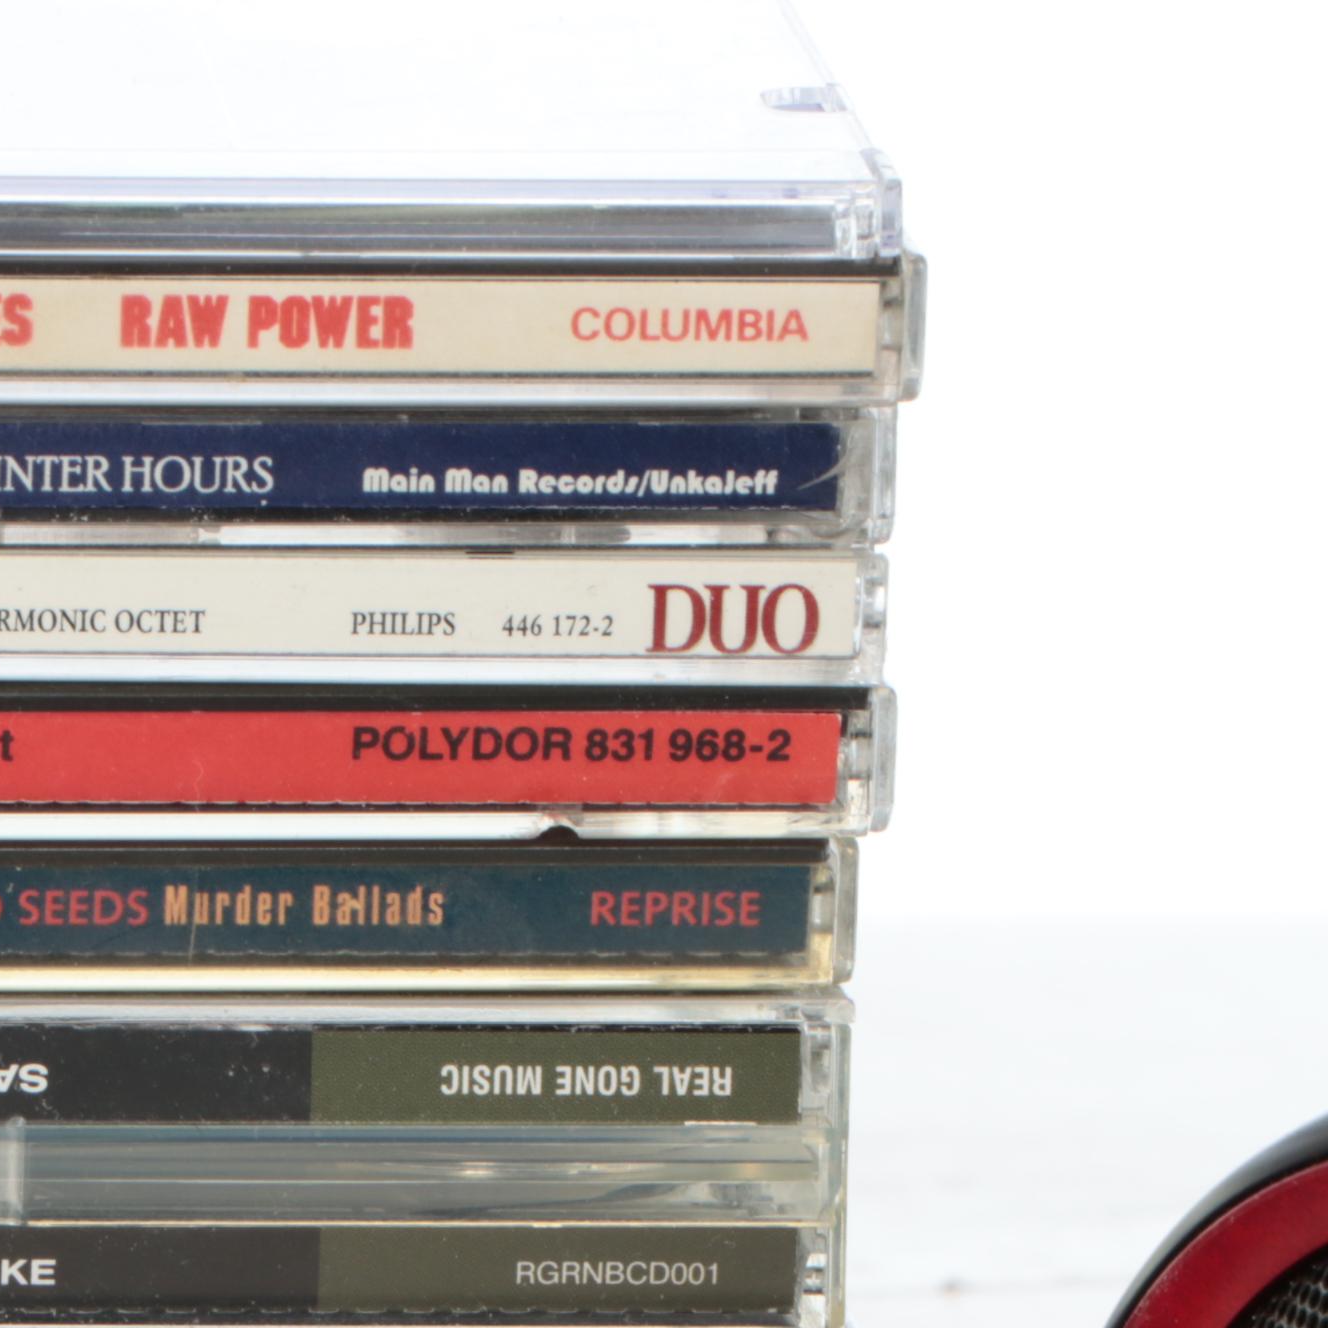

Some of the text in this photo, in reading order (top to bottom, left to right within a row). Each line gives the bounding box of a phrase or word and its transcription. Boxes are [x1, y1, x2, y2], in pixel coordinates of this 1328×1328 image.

[121, 295, 229, 348] RAW
[248, 296, 413, 349] POWER
[571, 307, 809, 342] COLUMBIA
[121, 456, 274, 493] HOURS
[363, 467, 435, 493] Main
[445, 468, 508, 493] Man
[114, 610, 205, 633] OCTET
[352, 584, 819, 659] PHILIPS 446 172-2 DUO
[352, 726, 572, 761] POLYDOR
[585, 728, 654, 762] 831
[669, 728, 791, 762] 968-2
[19, 889, 149, 926] SEEDS
[164, 885, 294, 926] Murder
[313, 885, 444, 926] Ballads
[591, 891, 760, 927] REPRISE
[441, 1065, 732, 1096] REAL GONE MUSIC
[516, 1261, 717, 1285] RGRNBCD001
